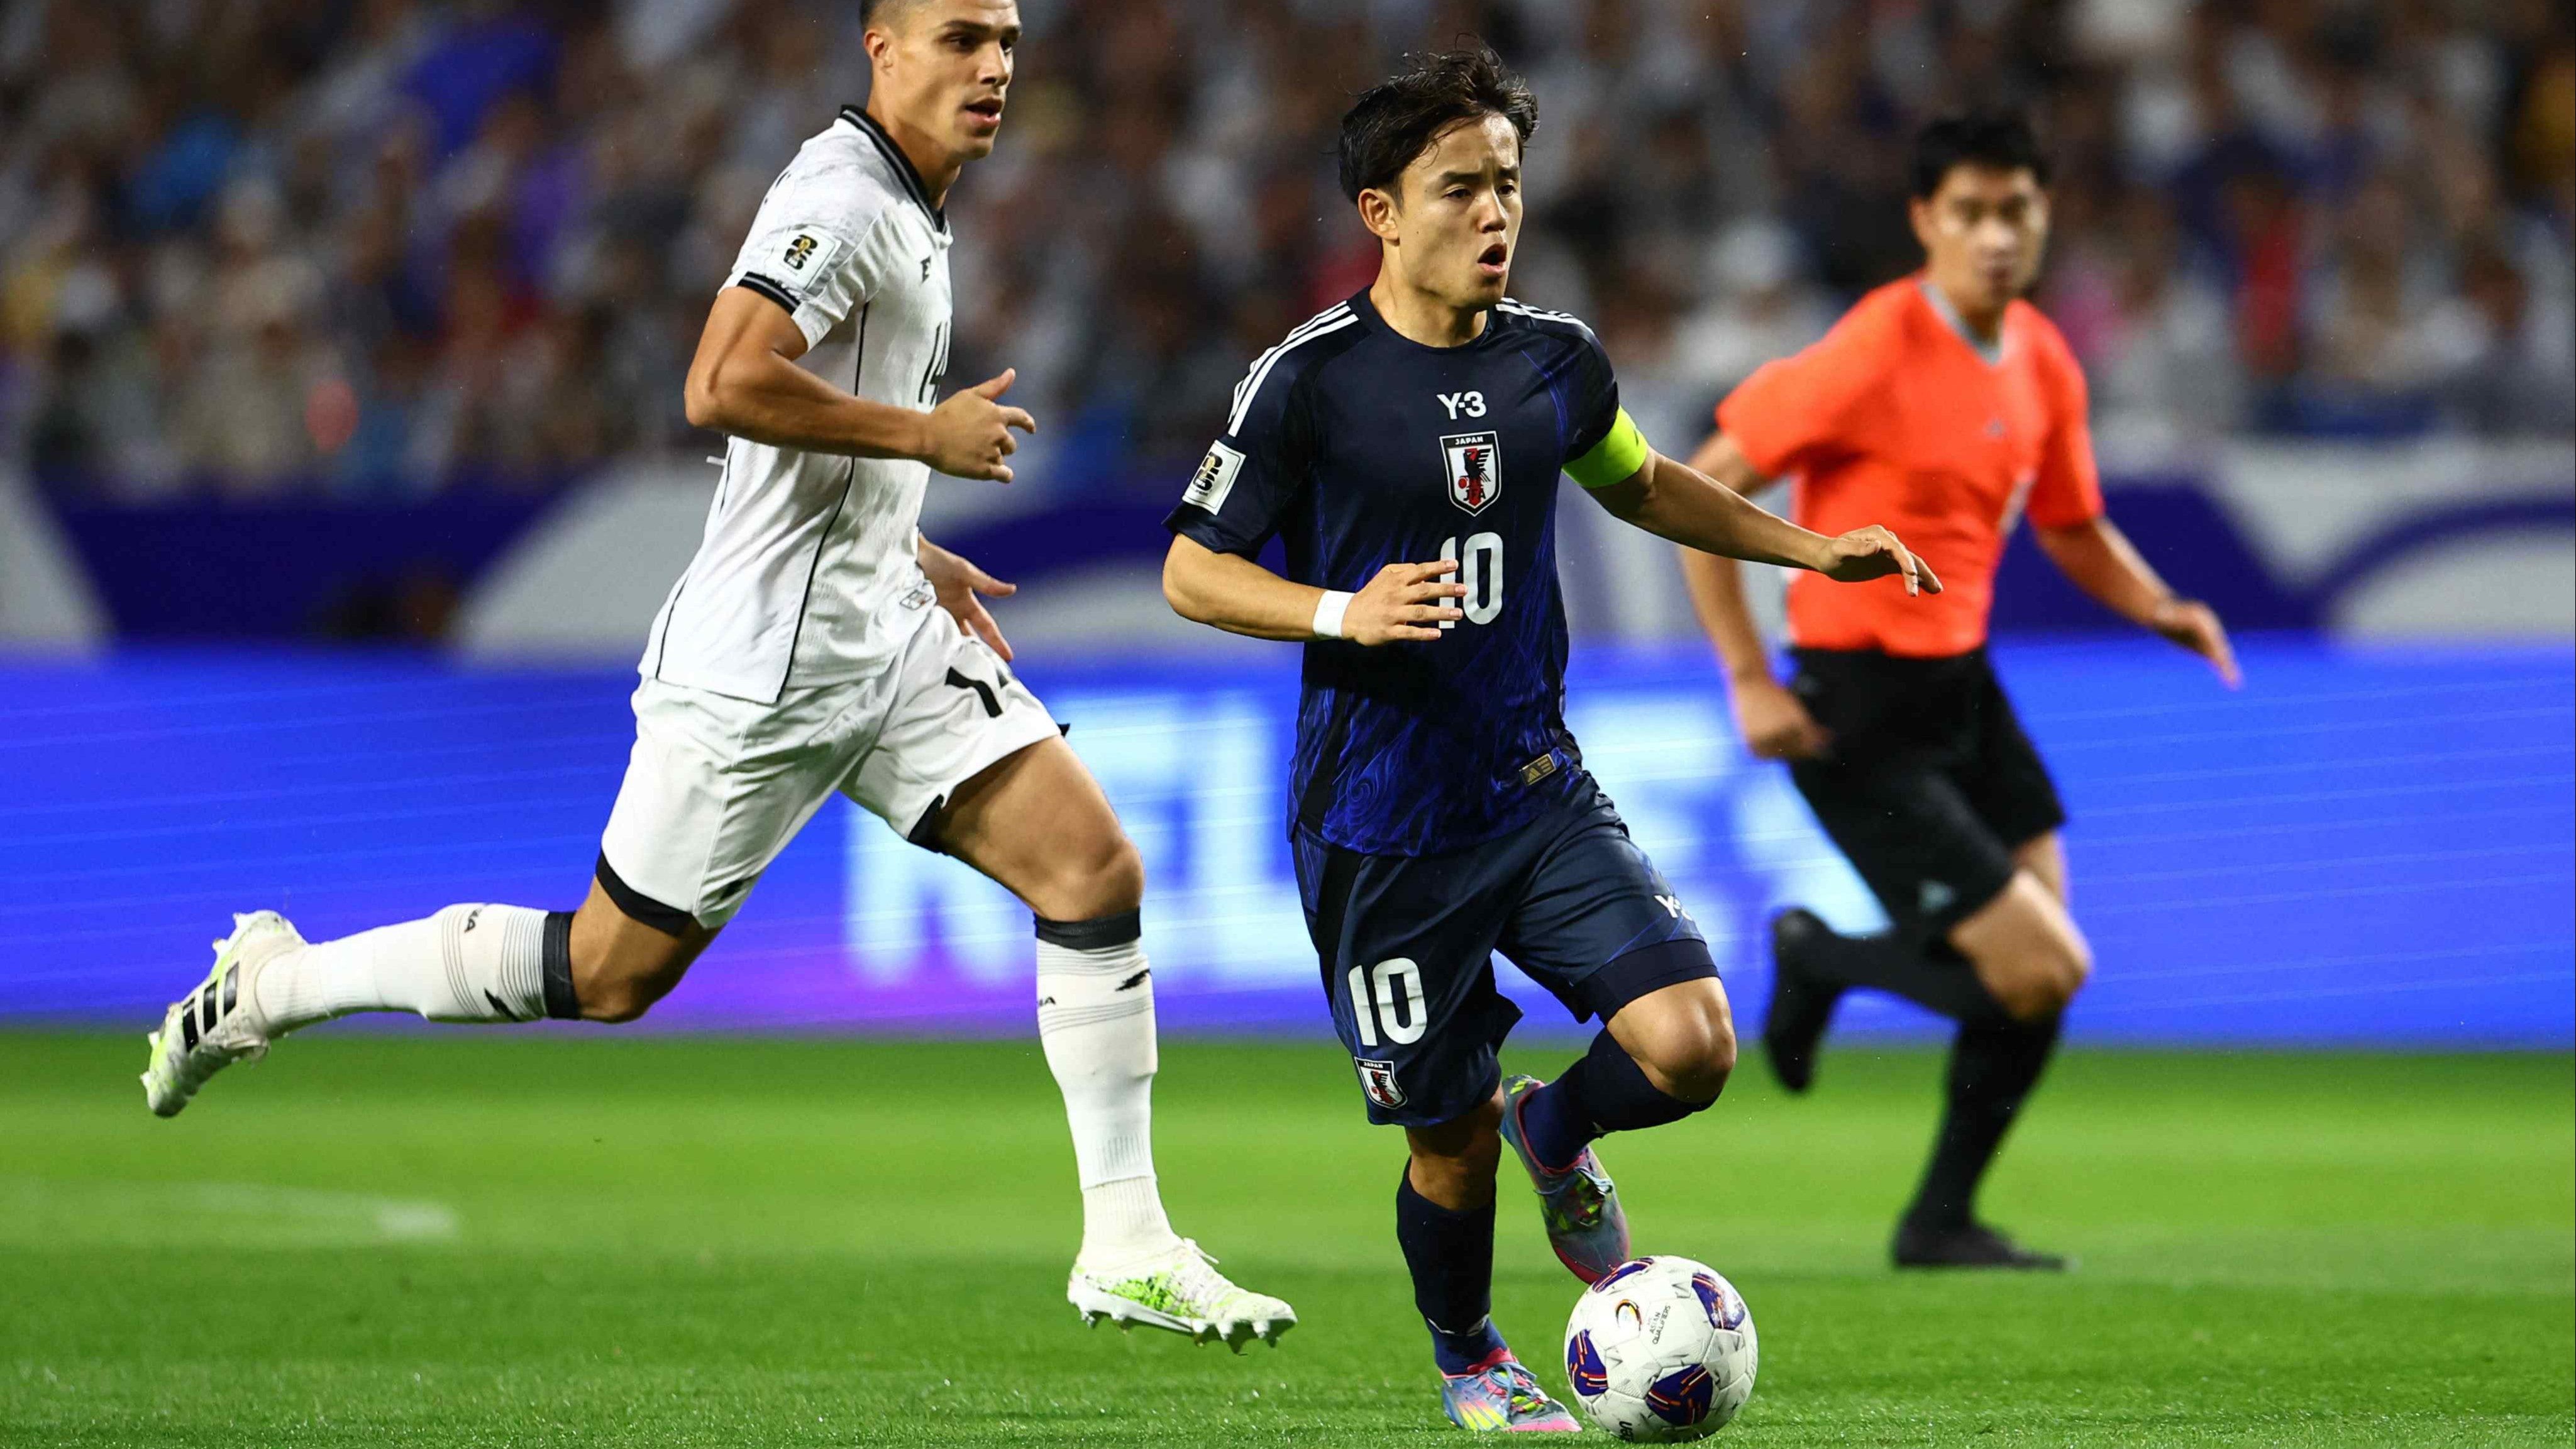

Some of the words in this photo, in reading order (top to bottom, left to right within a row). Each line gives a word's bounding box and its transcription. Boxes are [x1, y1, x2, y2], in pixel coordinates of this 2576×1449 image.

[1437, 391, 1486, 419] Y-3
[1455, 436, 1484, 445] JAPAN
[1438, 532, 1503, 629] 10
[944, 665, 1009, 718] 1
[1348, 957, 1429, 1046] 10
[1649, 1312, 1661, 1334] ASIAN
[1652, 1306, 1671, 1345] QUALIFIERS
